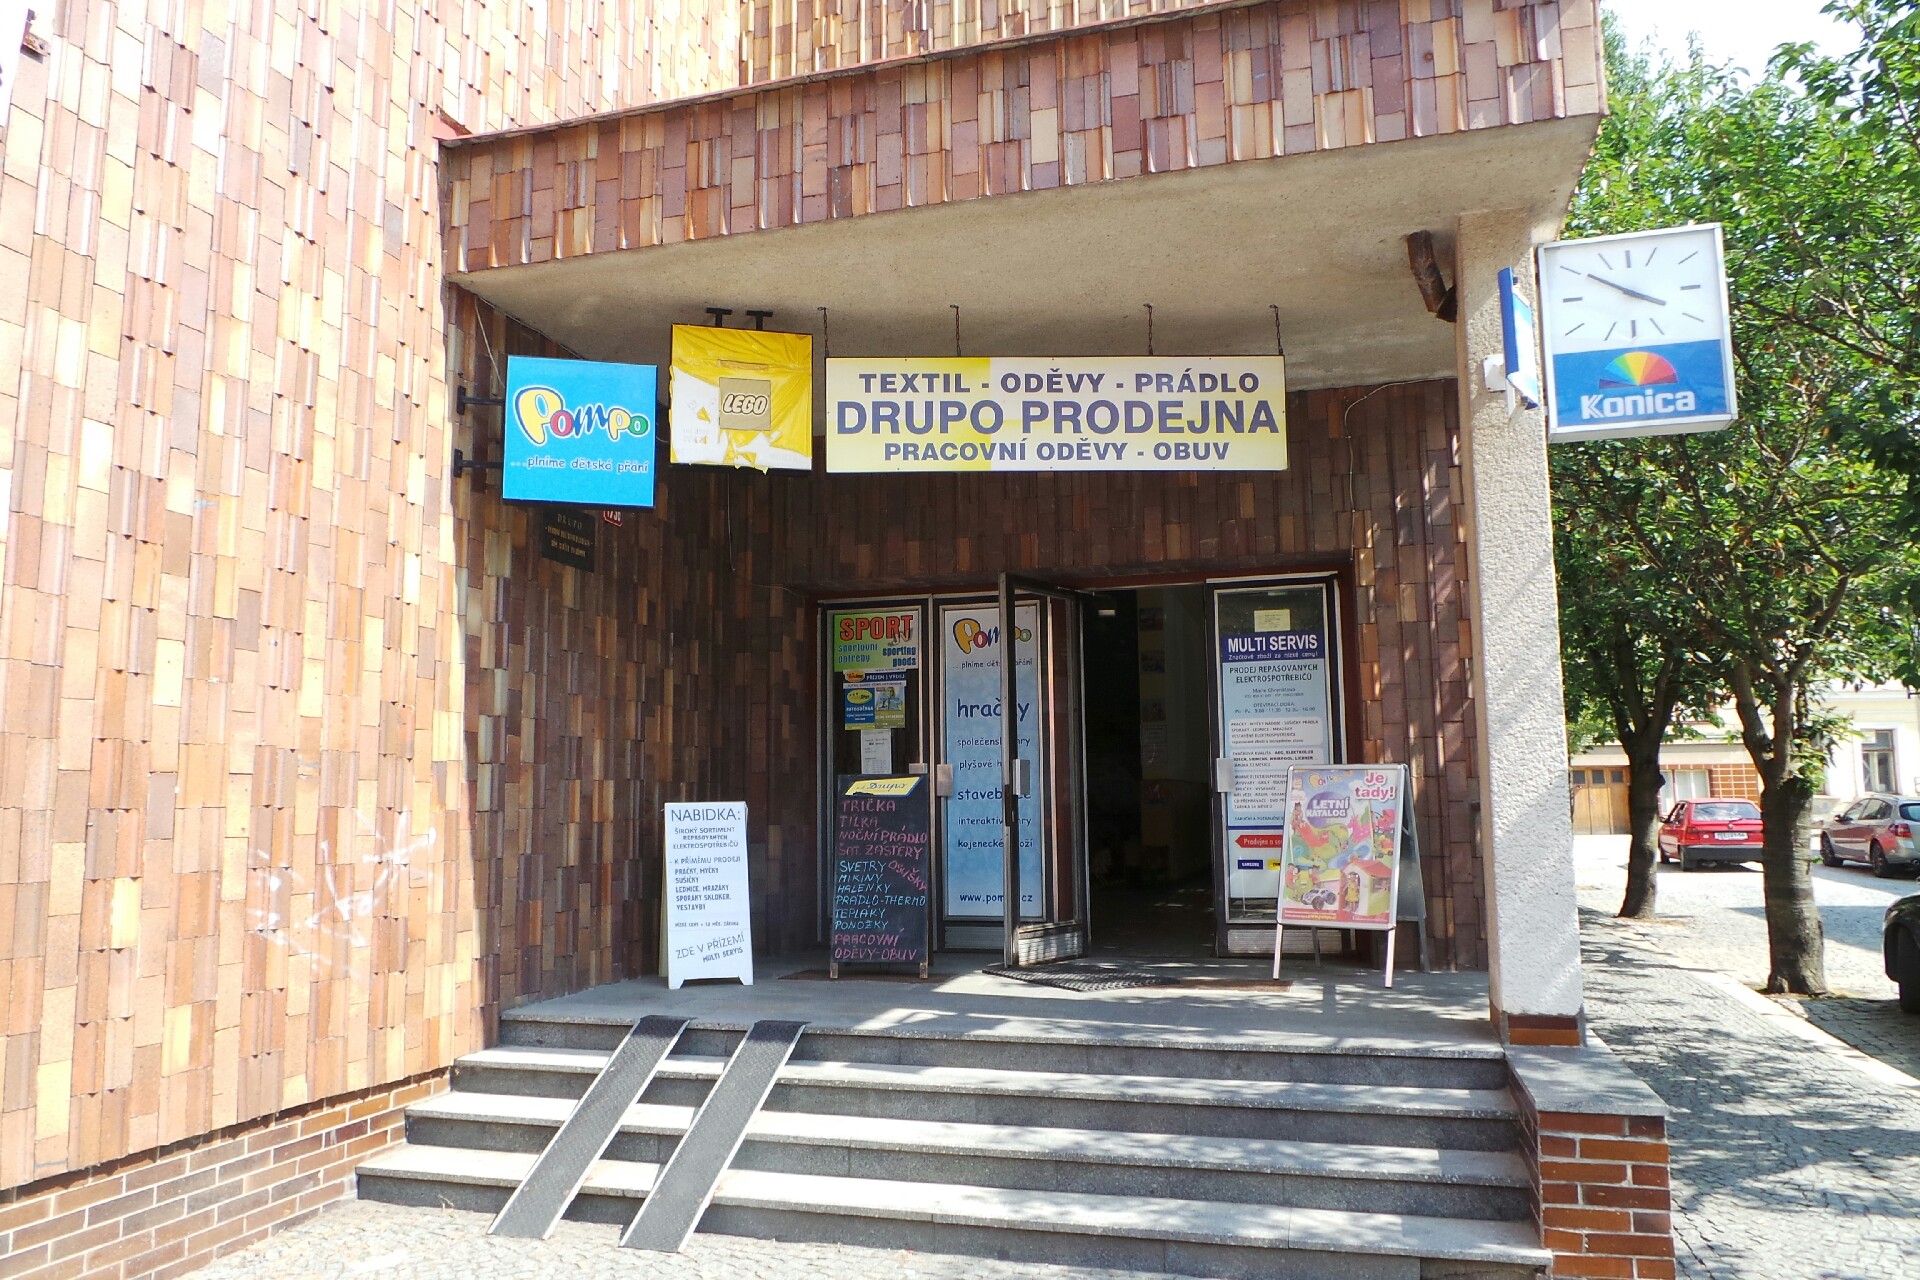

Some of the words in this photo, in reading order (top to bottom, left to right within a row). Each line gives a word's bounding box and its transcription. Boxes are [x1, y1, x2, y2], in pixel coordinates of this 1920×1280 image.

[859, 373, 970, 393] TEXTIL
[1000, 368, 1105, 393] ODĚVY
[1135, 368, 1259, 393] PRÁDLO
[722, 393, 768, 415] LEGO
[1580, 389, 1695, 419] Konica
[513, 385, 650, 446] Pompo
[837, 399, 1004, 434] DRUPO
[1022, 399, 1279, 434] PRODEJNA
[884, 437, 1026, 461] PRACOVNÍ
[1036, 437, 1128, 461] ODĚVY
[1153, 442, 1230, 461] OBUV
[571, 457, 612, 471] dětská
[617, 461, 649, 474] přání
[840, 615, 913, 641] SPORT
[1228, 636, 1266, 653] MULTI
[1270, 633, 1318, 651] SERVIS
[882, 646, 917, 656] sporting
[892, 657, 917, 667] goods
[1230, 666, 1256, 674] PRODEJ
[1258, 663, 1318, 673] REPASOVANÝCH
[957, 698, 1030, 722] hračy
[957, 737, 1002, 748] společens
[959, 758, 992, 770] plyšové
[1365, 772, 1385, 784] Je
[958, 787, 1031, 800] staveb
[1355, 786, 1394, 800] tady!
[841, 798, 896, 812] TRIČKA
[1313, 797, 1350, 809] LETNÍ
[671, 808, 741, 822] NABIDKA:
[958, 817, 1003, 825] interaktiv
[1306, 810, 1346, 818] KATALOG
[839, 827, 881, 841] NOČNÍ
[881, 825, 928, 844] PRÁDLO
[958, 839, 1004, 850] kojenecké
[1243, 838, 1268, 846] Prodejna
[839, 860, 887, 873] SVETRY
[838, 873, 884, 883] MIKINY
[837, 883, 891, 894] HALENKY
[959, 894, 1033, 904] www.pomcz
[835, 905, 886, 919] TEPLÁKY
[834, 919, 889, 930] PONOŽKY
[834, 927, 905, 947] PRACOVNÍ
[675, 946, 695, 959] ZDE
[696, 944, 704, 952] V
[707, 931, 745, 951] PŘÍZEMÍ
[702, 952, 720, 963] MULTI
[722, 946, 744, 957] SERVIS
